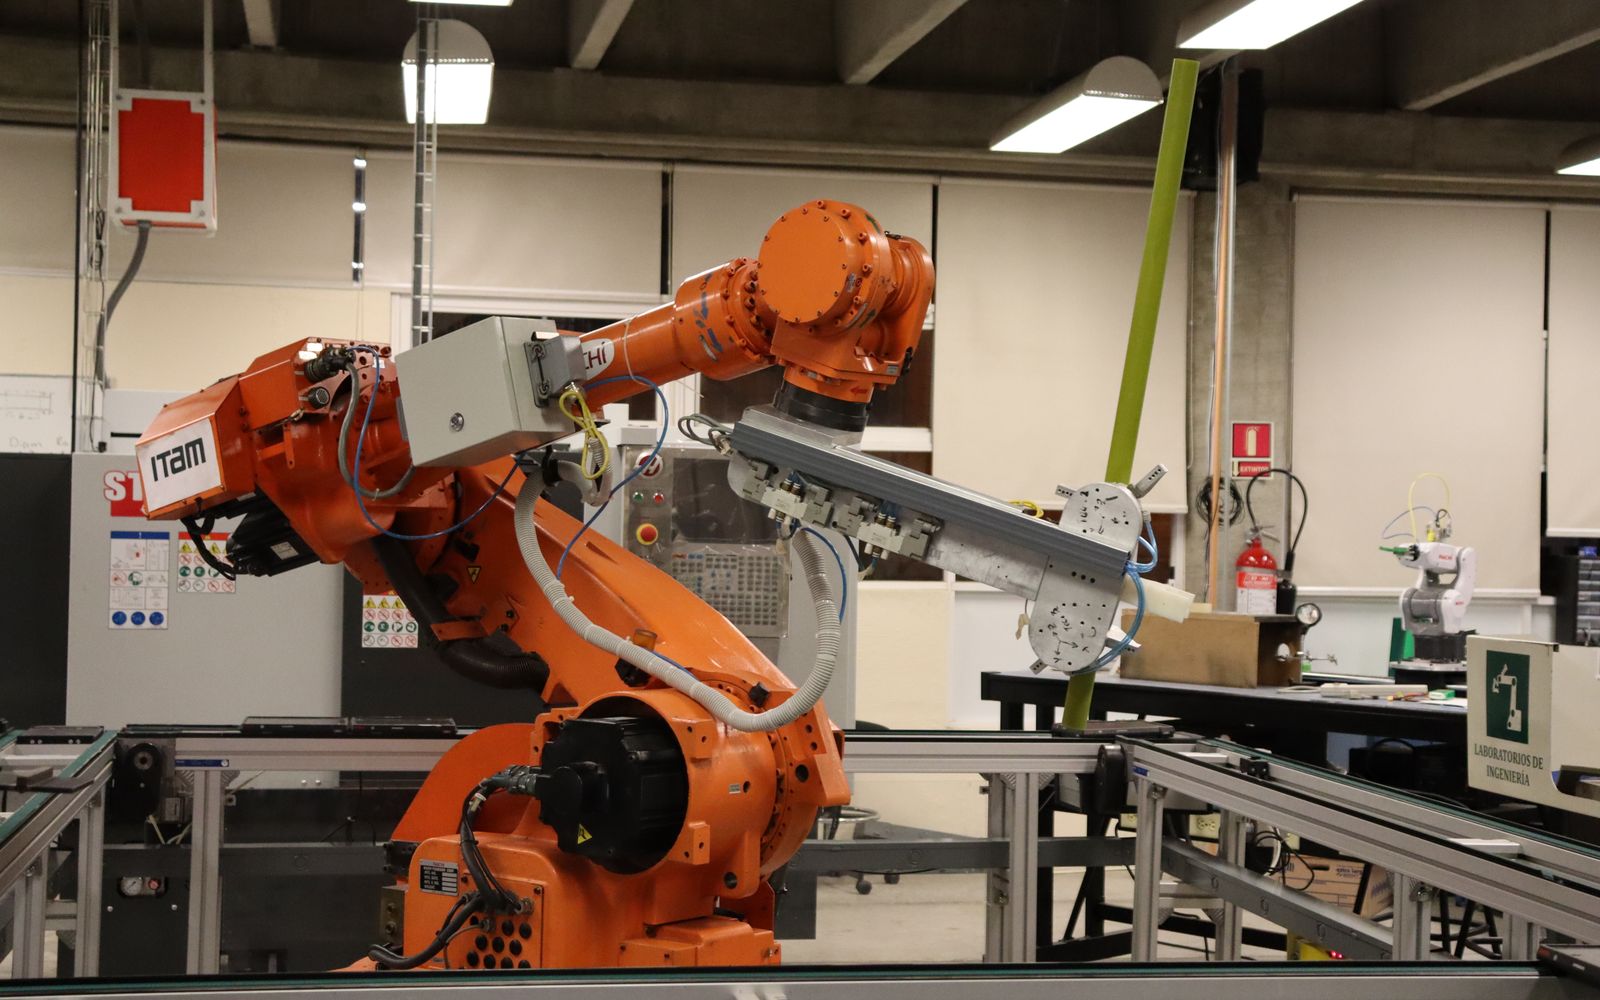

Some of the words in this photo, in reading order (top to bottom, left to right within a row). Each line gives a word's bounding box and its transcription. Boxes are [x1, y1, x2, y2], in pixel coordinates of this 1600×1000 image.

[1474, 743, 1531, 767] LABORATORIOS
[1532, 755, 1544, 770] DE
[1486, 764, 1530, 787] INGENIERÍA
